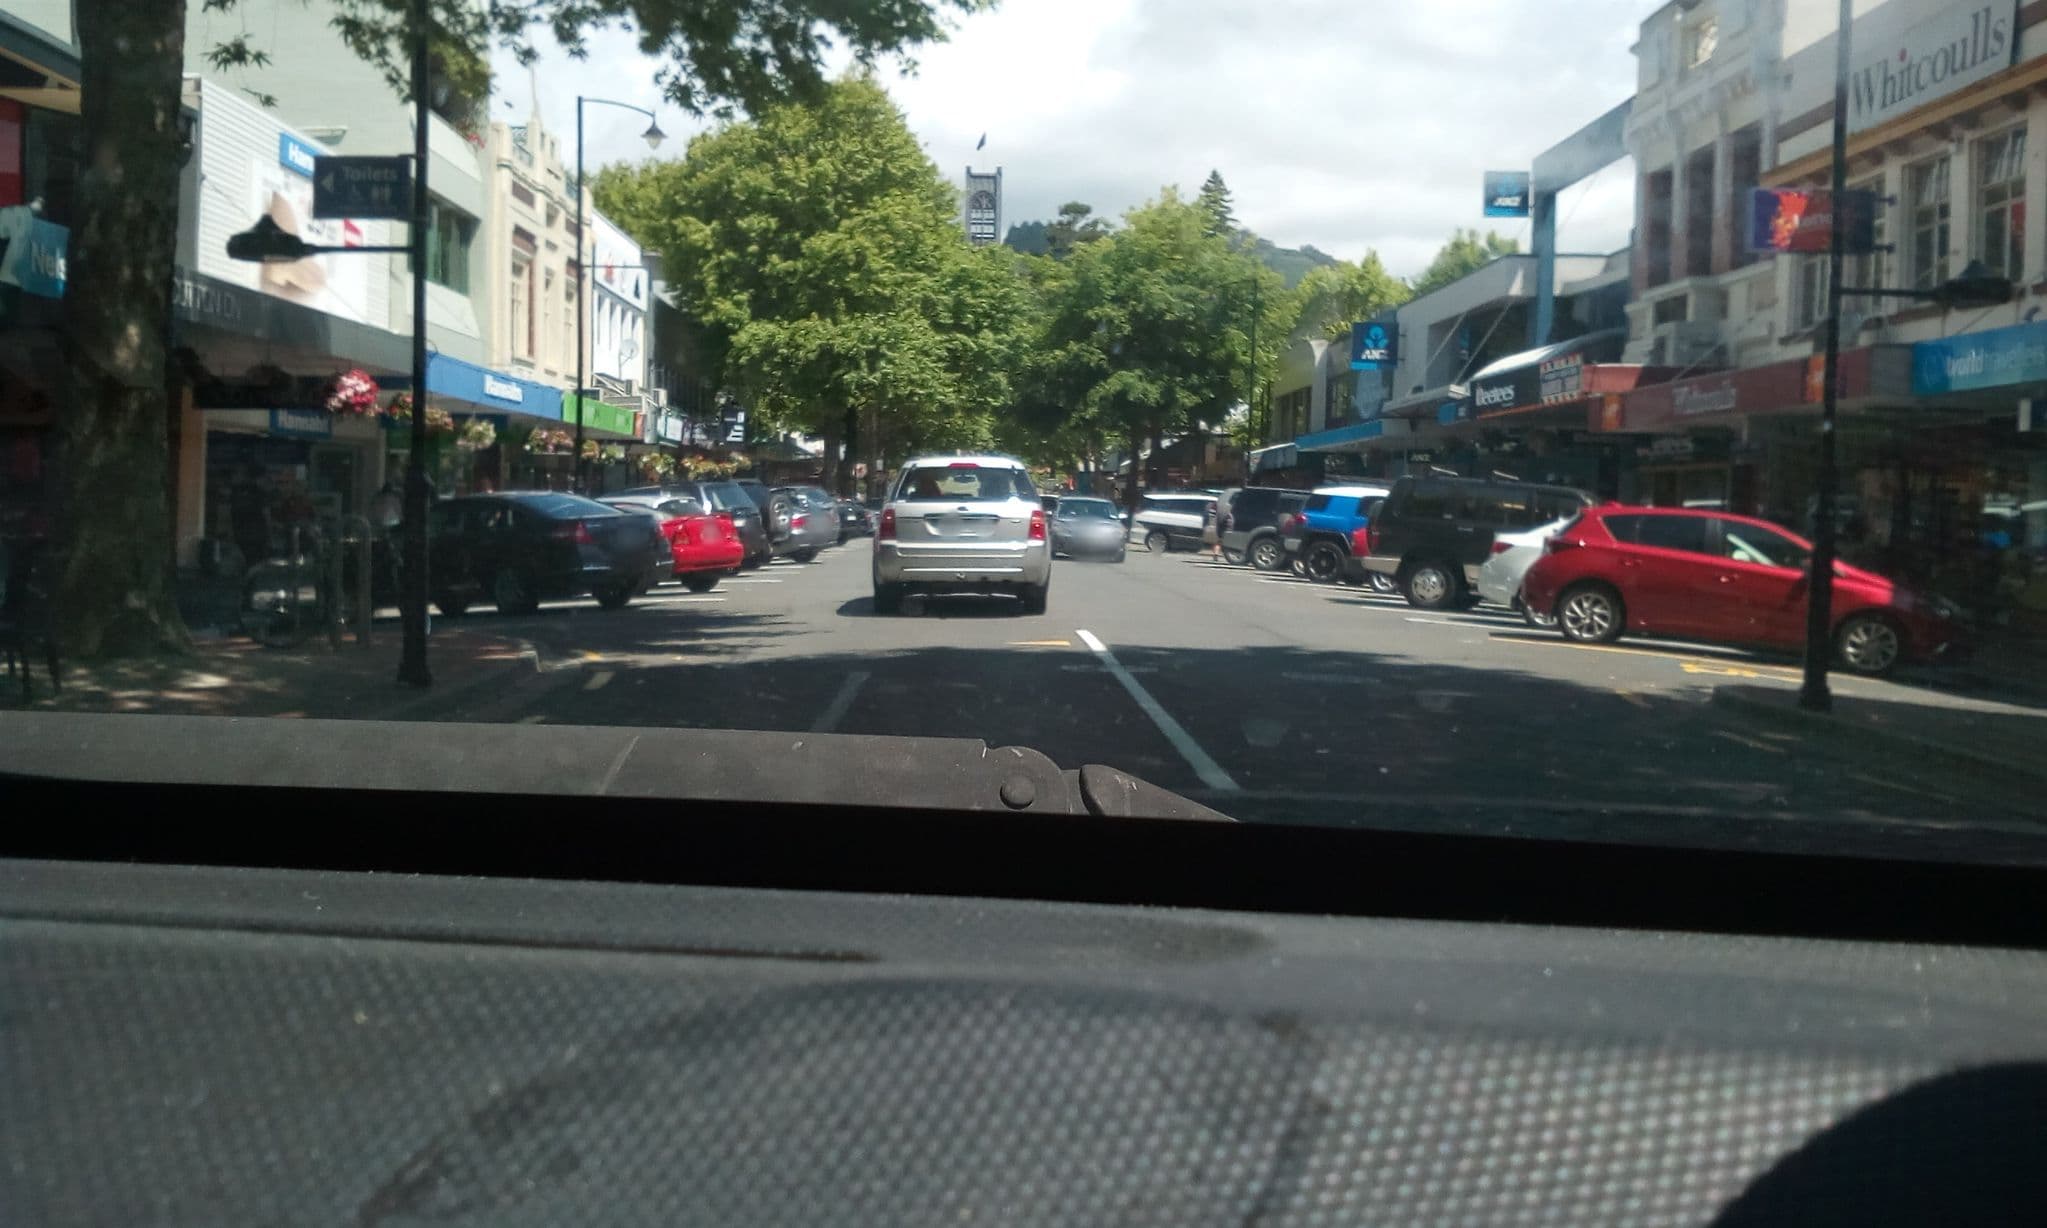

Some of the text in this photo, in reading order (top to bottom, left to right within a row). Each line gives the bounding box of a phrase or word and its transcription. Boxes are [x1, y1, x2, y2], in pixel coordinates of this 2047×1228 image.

[1852, 6, 2006, 117] Whitcoulls
[342, 166, 398, 181] Toilets
[1361, 349, 1389, 360] ANZ
